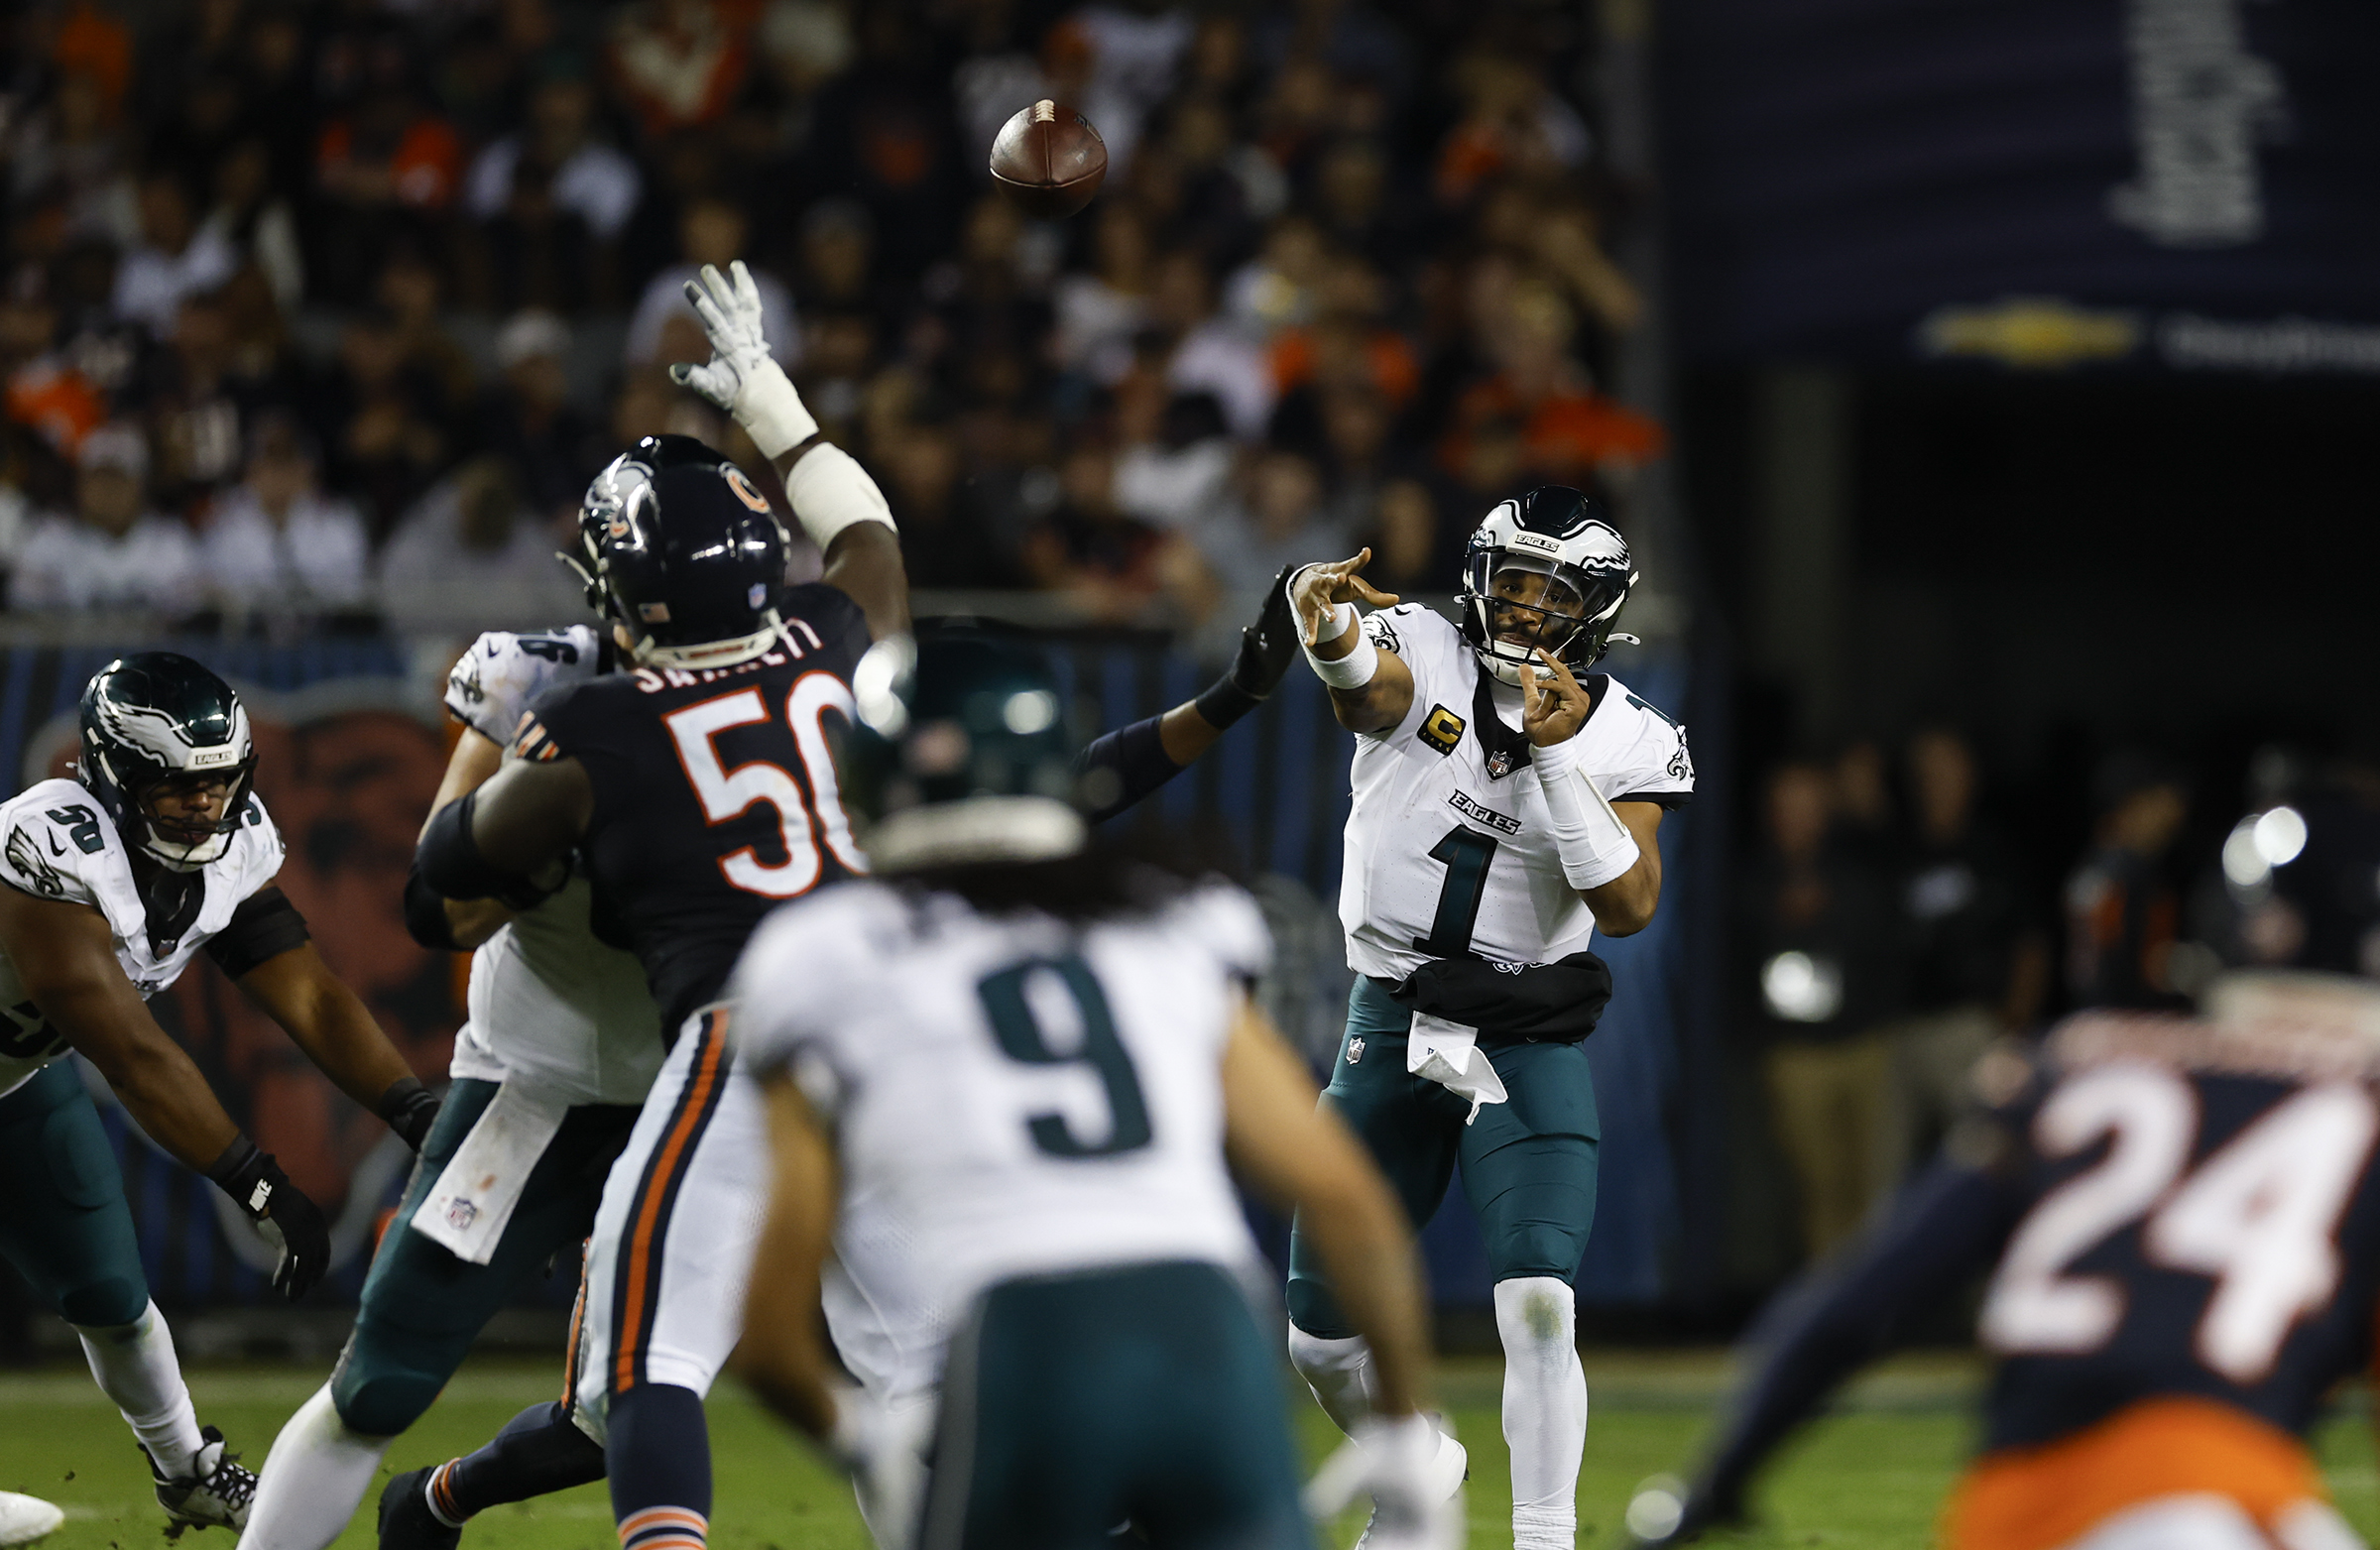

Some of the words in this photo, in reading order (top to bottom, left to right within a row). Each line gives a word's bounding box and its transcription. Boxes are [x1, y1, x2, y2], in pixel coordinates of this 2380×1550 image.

[1515, 535, 1560, 552] EAGLES
[1427, 709, 1463, 744] C
[1449, 789, 1521, 835] EAGLES
[1412, 824, 1498, 960] 1
[976, 954, 1153, 1161] 9
[249, 1178, 273, 1212] NIKE
[1977, 1057, 2378, 1384] 24
